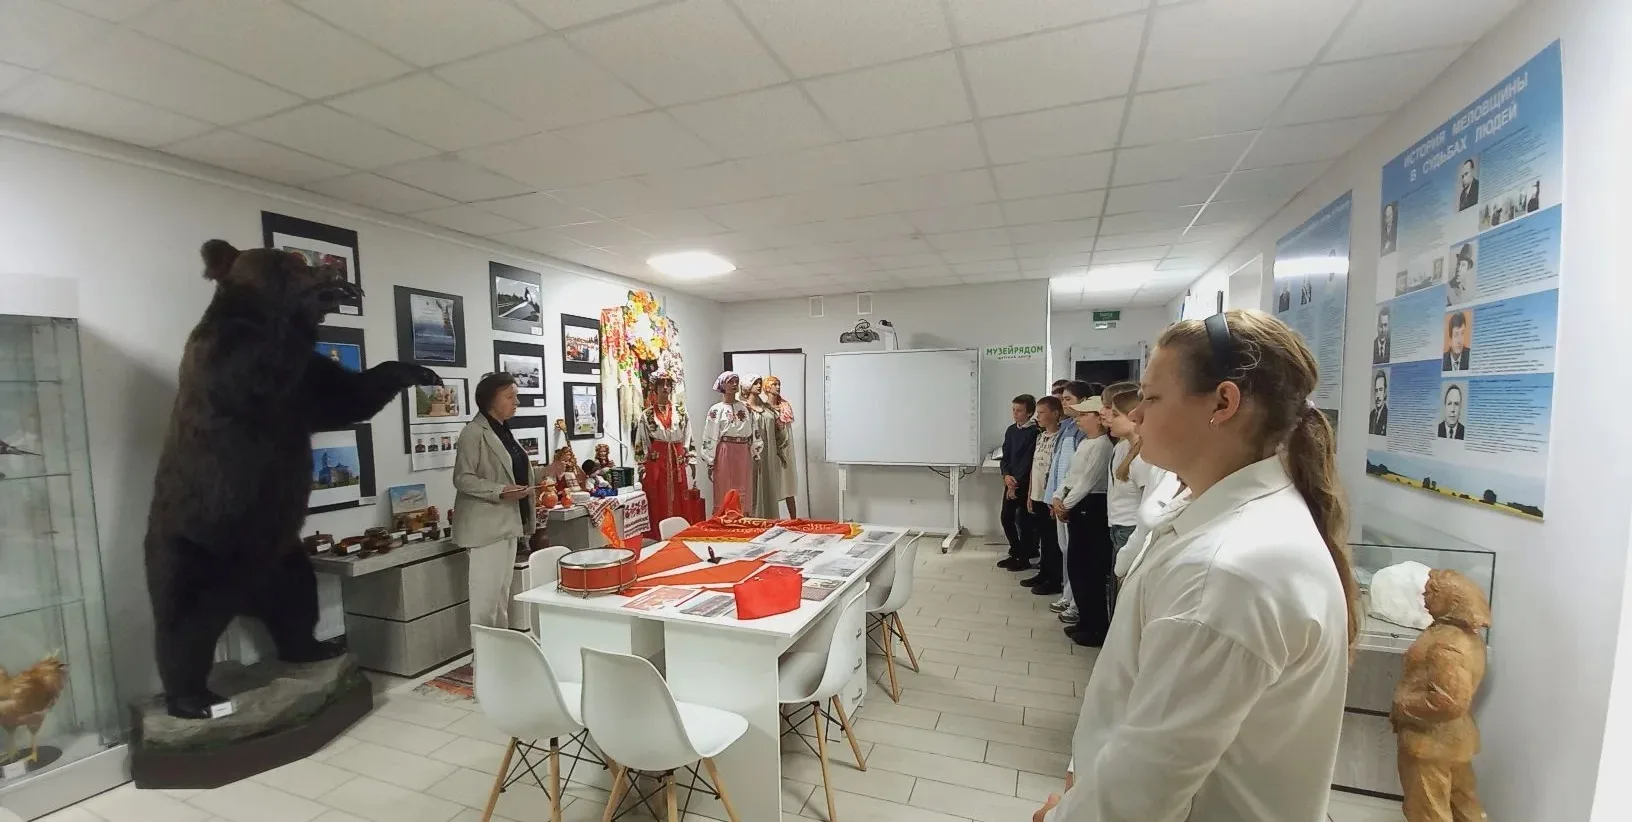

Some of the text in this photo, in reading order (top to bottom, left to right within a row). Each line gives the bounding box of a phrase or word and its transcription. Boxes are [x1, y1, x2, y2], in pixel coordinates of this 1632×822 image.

[1404, 130, 1446, 168] ИСТОРИЯ
[1452, 71, 1528, 136] МЕЛОВЩИНЫ
[1410, 168, 1417, 182] В
[1422, 134, 1468, 174] СУДЬБАХ
[1475, 100, 1518, 142] ЛЮДЕЙ
[986, 344, 1043, 356] МУЗЕЙРЯДОМ
